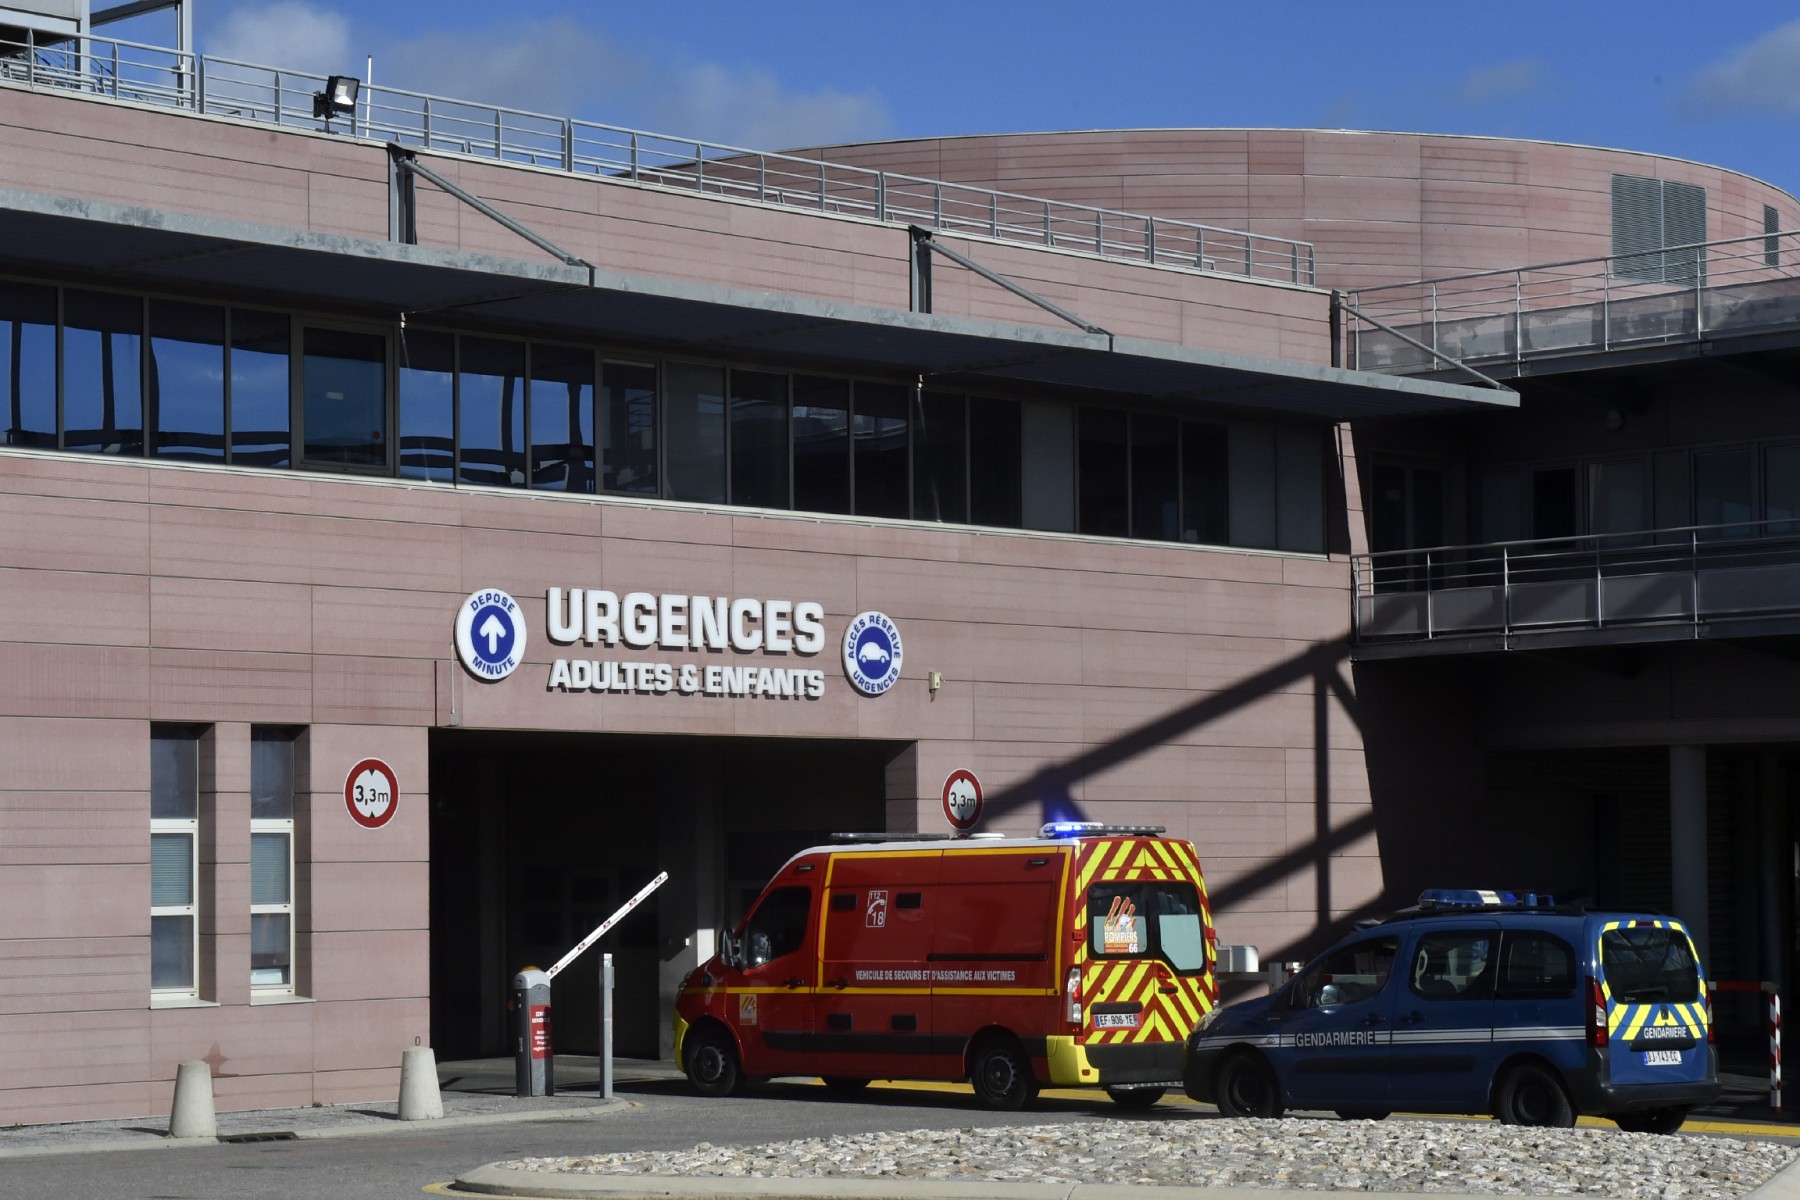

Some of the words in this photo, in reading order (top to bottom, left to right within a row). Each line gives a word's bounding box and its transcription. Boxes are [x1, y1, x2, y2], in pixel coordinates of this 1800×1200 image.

[470, 593, 515, 613] DEPOSE
[548, 587, 826, 654] URGENCES
[869, 614, 901, 659] RÉSERVÉ
[472, 656, 515, 675] MINUTE
[549, 659, 673, 693] ADULTES
[678, 664, 699, 693] &
[704, 665, 826, 698] ENFANTS
[853, 667, 898, 692] URGENCES
[355, 784, 389, 806] 3,3m
[950, 791, 976, 810] 3,3m
[870, 892, 881, 900] 112
[872, 911, 884, 925] 18
[1104, 931, 1138, 942] POMPIERS
[1128, 943, 1138, 953] 66
[855, 970, 884, 980] VEHICULE
[885, 970, 893, 980] DE
[894, 970, 922, 980] SECOURS
[922, 970, 931, 980] ET
[931, 970, 973, 981] D'ASSISTANCE
[974, 970, 986, 981] AUX
[986, 971, 1016, 981] VICTIMES
[1296, 1031, 1374, 1047] GENDARMERIE
[1643, 1027, 1687, 1039] GENDARMERIE
